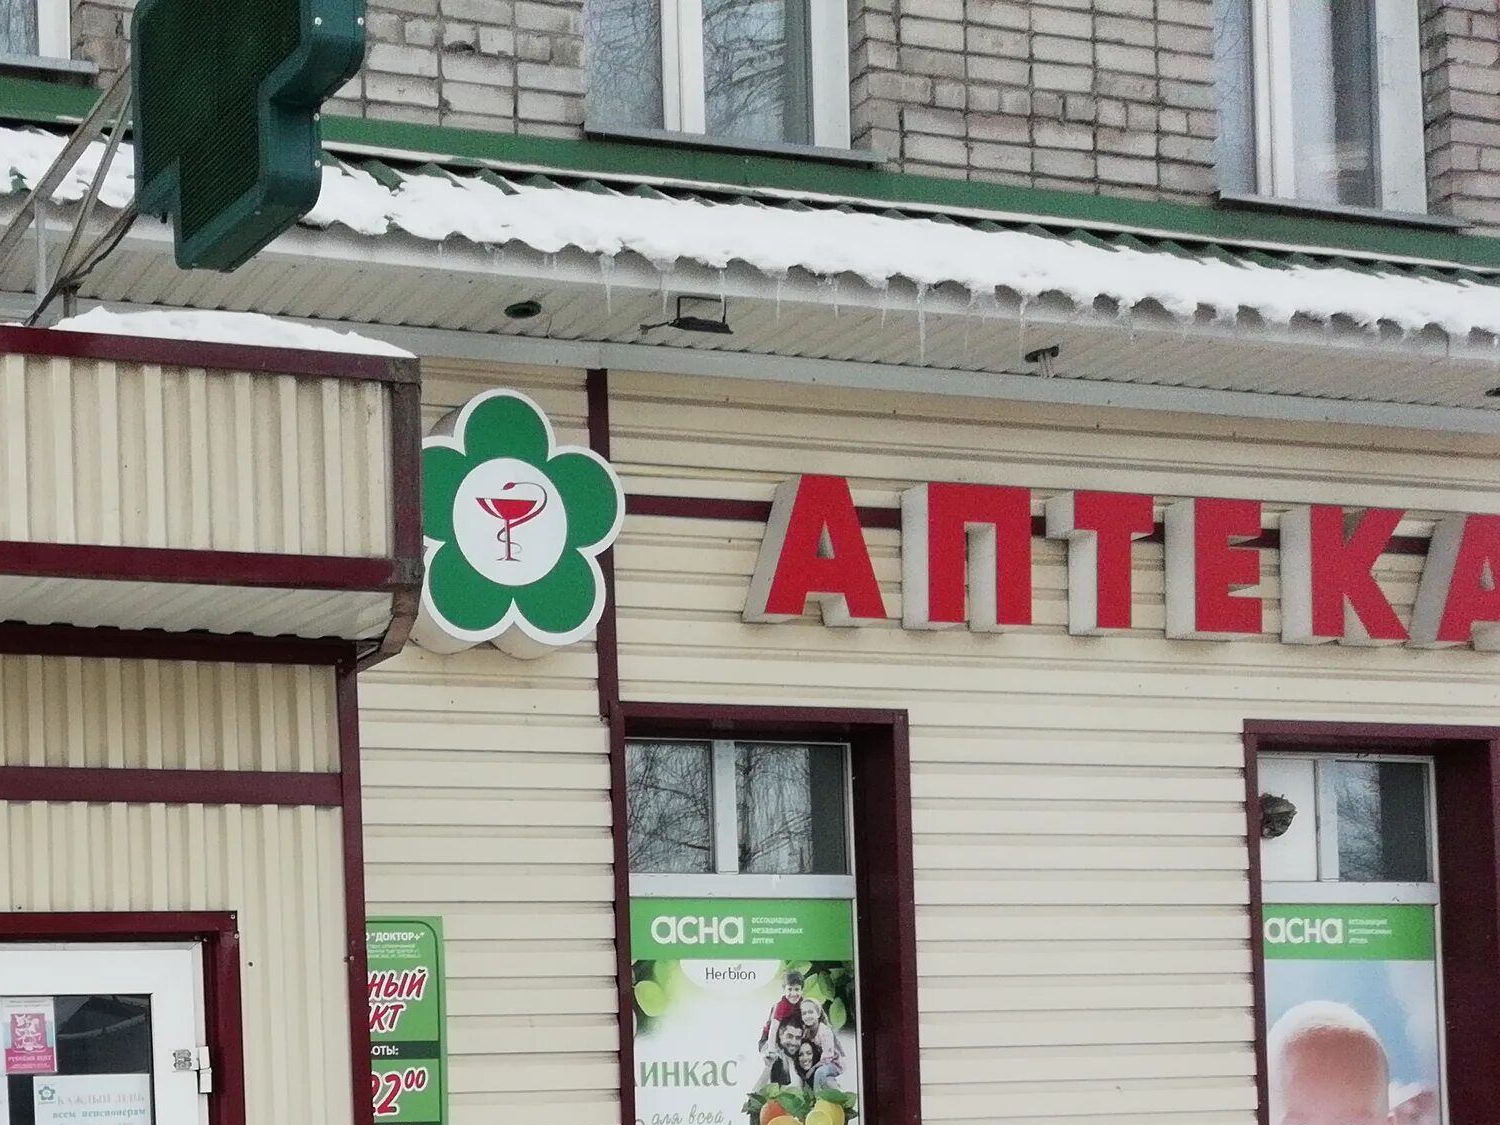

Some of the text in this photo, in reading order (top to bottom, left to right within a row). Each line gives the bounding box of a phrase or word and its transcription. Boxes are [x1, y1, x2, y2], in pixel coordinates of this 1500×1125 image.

[745, 472, 1500, 648] АПТЕКА
[650, 916, 744, 944] асна
[1263, 917, 1343, 944] асна
[705, 964, 756, 980] Herbion
[368, 1003, 406, 1032] КТ
[370, 1045, 399, 1055] ОТЫ:
[635, 1060, 738, 1088] инкас
[688, 1104, 725, 1125] всей
